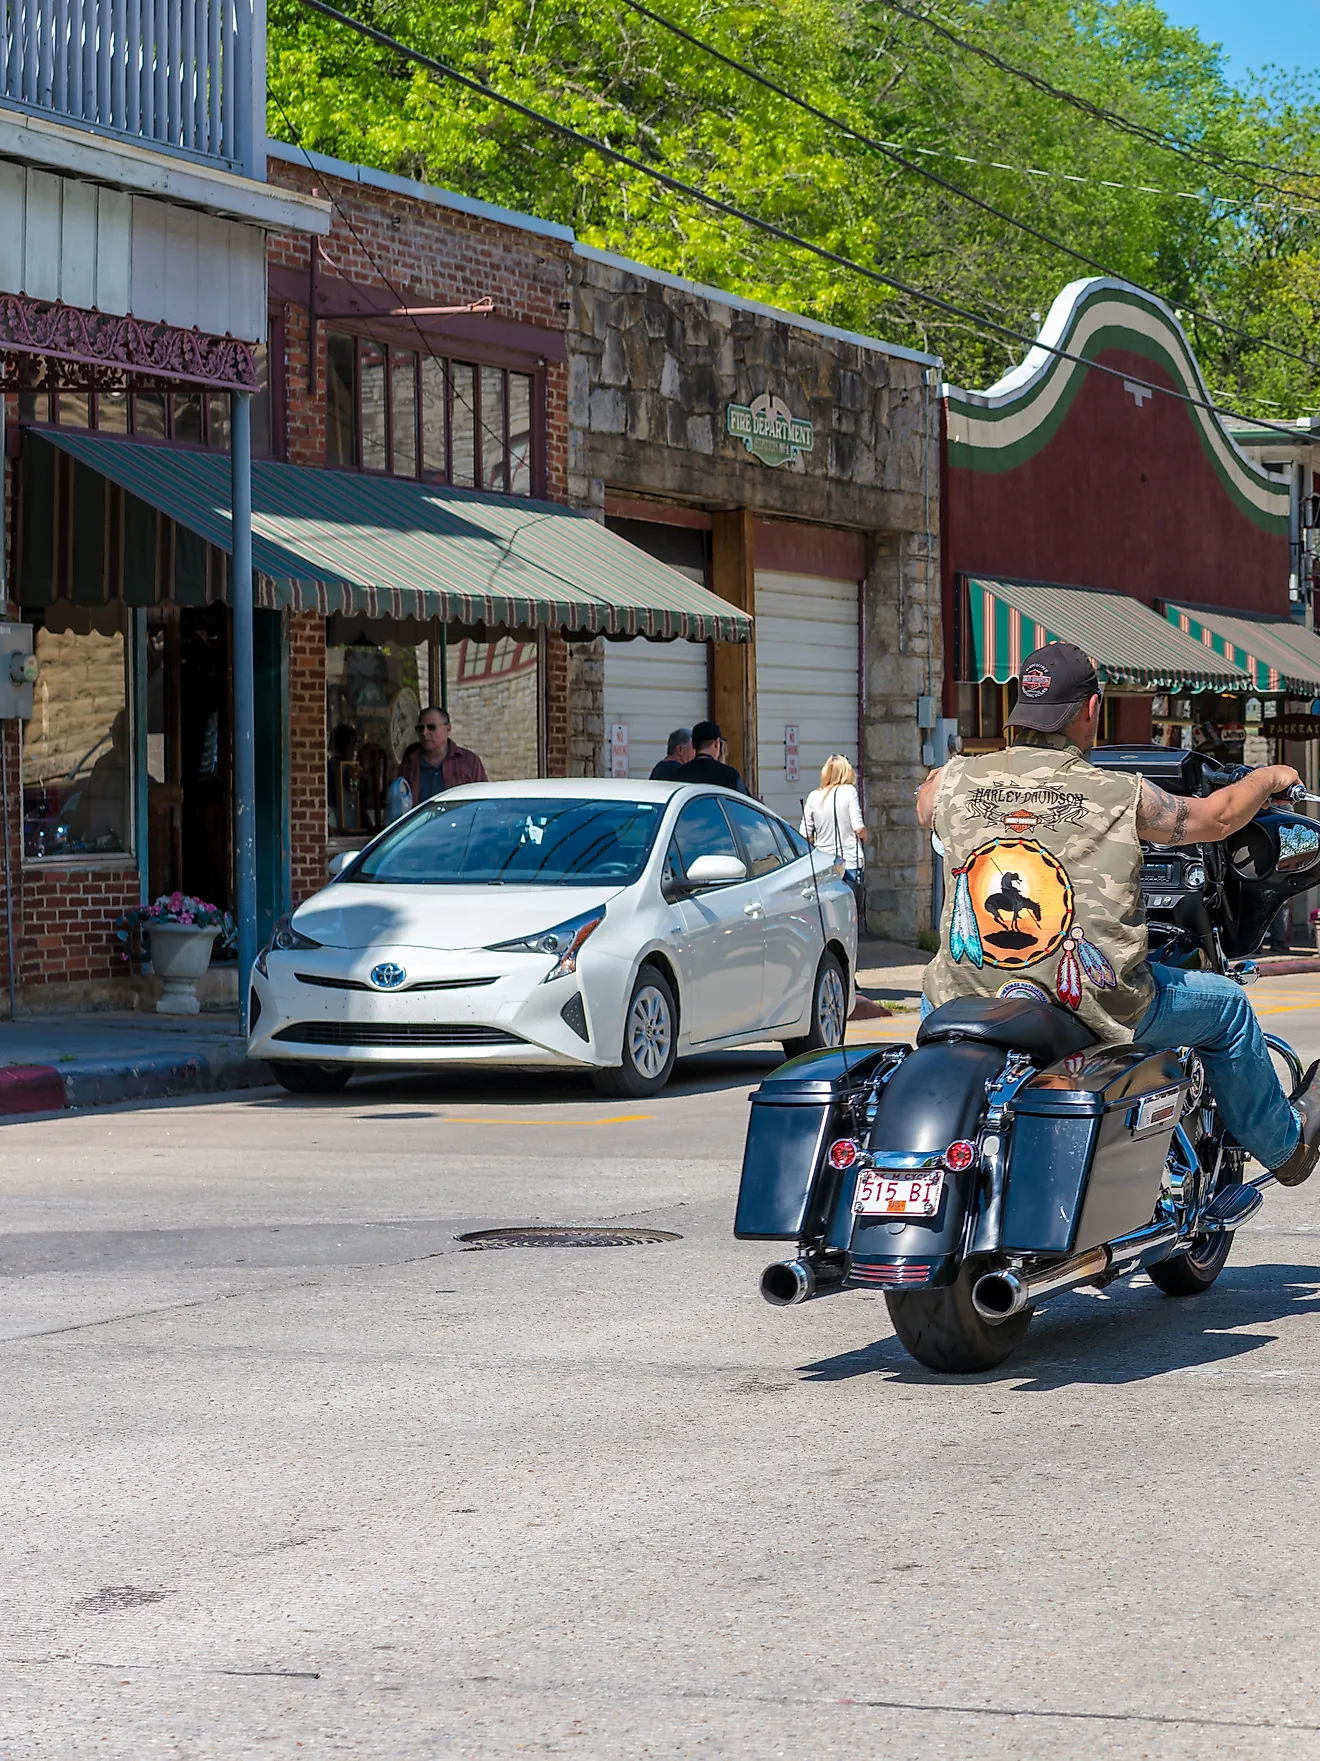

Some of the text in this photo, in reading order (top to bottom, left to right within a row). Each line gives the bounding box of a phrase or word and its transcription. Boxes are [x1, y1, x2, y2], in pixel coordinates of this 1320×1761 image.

[730, 410, 811, 446] FIRE DEPARTMENT
[1223, 731, 1244, 740] Jeep
[970, 784, 1088, 807] HARLEY-DAVIDSON
[861, 1182, 899, 1202] 515
